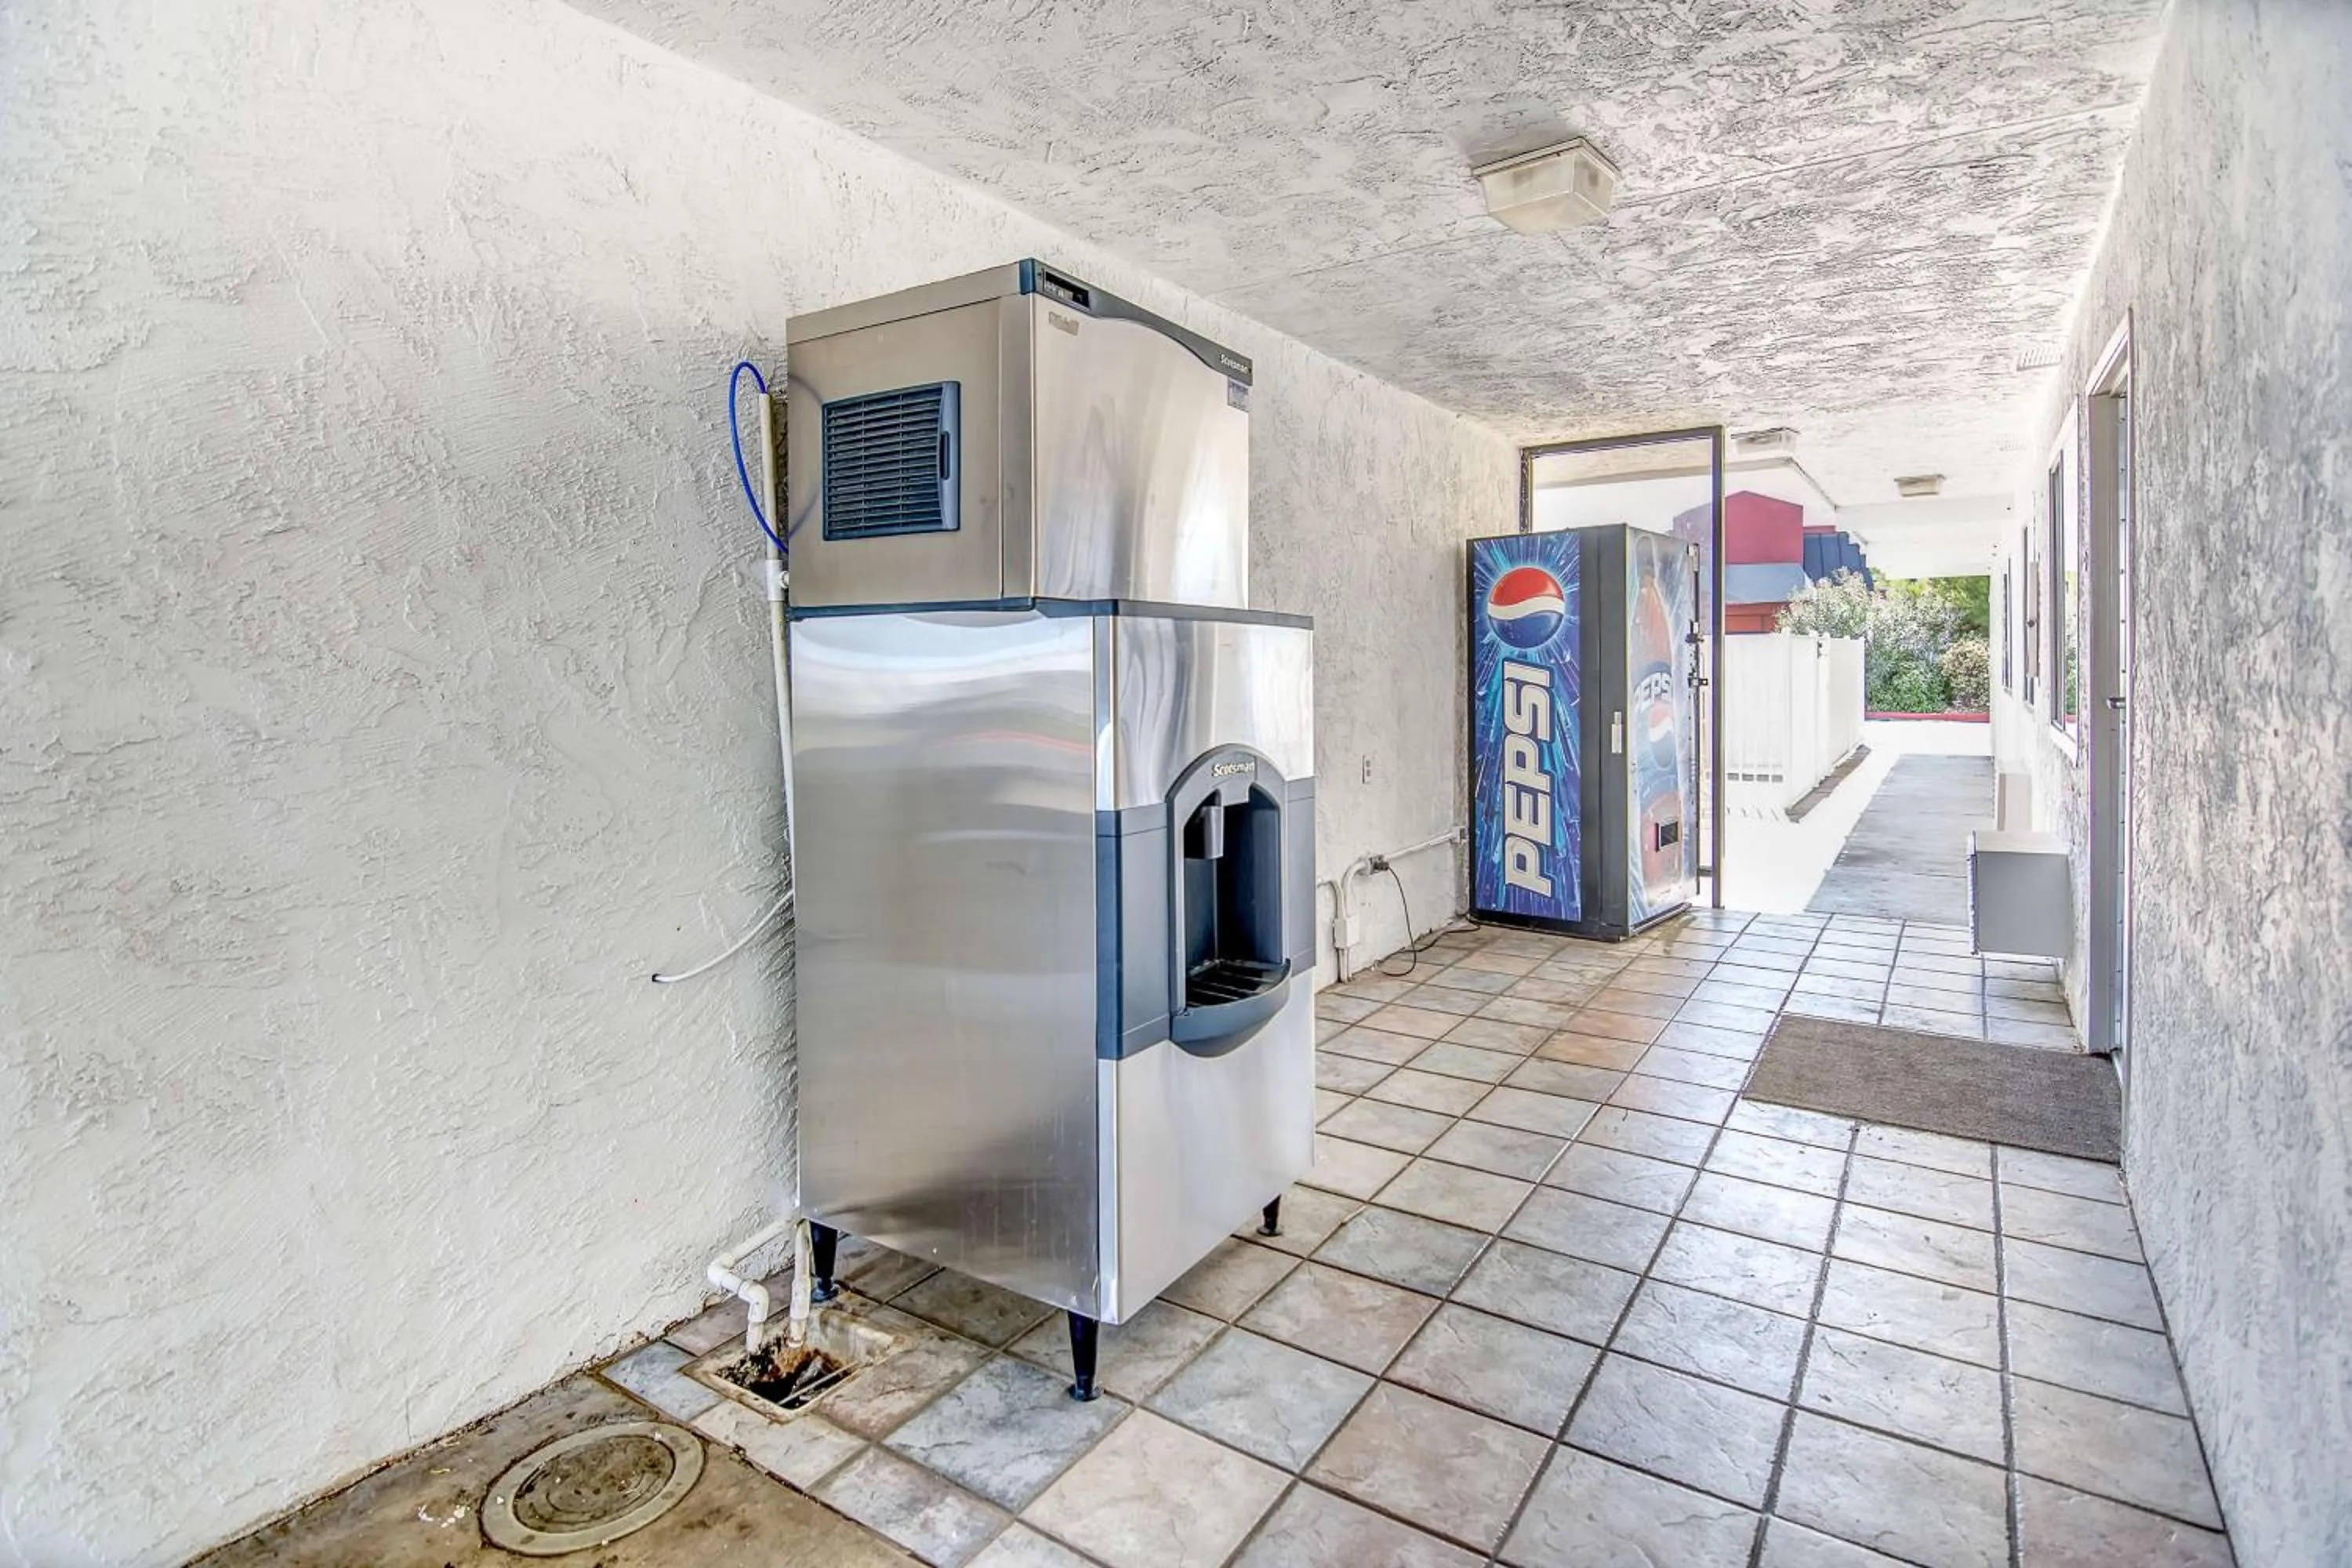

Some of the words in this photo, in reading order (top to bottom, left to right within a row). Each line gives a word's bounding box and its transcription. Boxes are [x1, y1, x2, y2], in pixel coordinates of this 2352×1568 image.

[1635, 672, 1673, 714] PEPS
[1214, 762, 1254, 777] Scotsman
[1504, 660, 1552, 898] PEPSI
